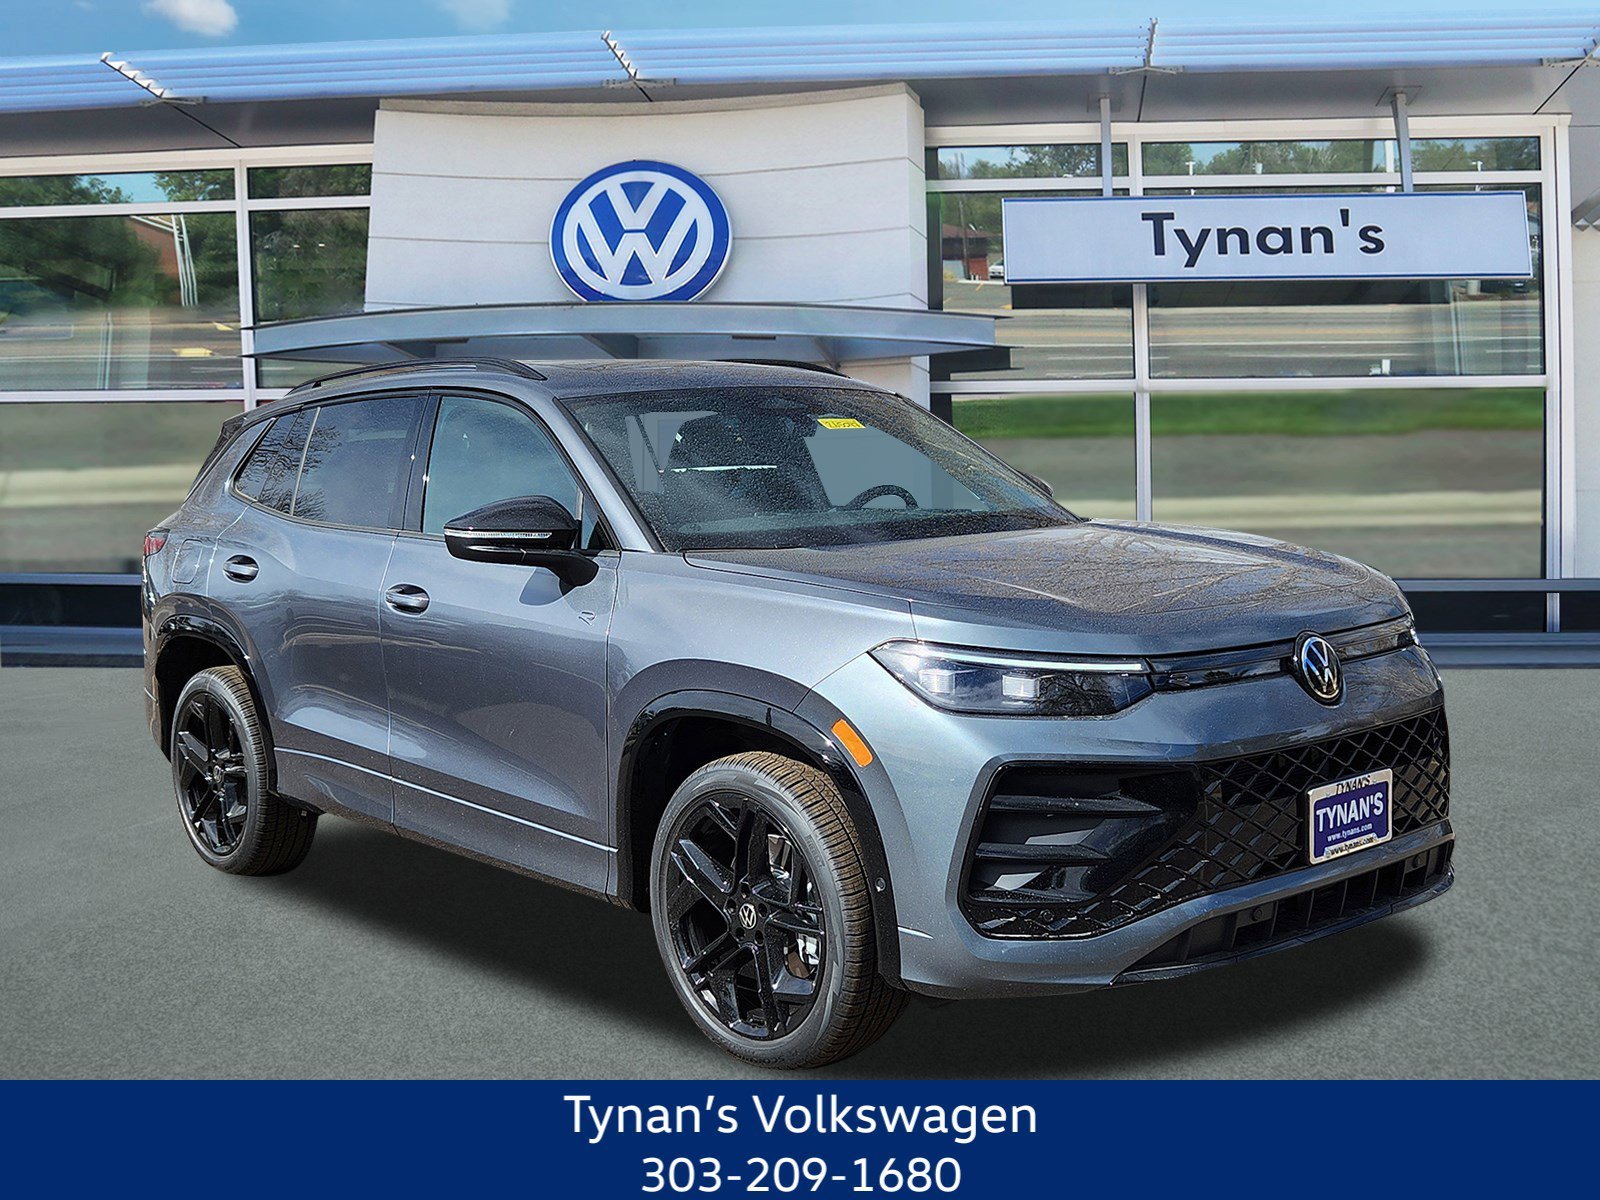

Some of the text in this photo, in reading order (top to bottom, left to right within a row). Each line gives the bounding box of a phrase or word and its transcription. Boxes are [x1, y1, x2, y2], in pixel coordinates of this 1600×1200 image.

[1142, 209, 1385, 268] Tynan's
[1316, 792, 1384, 832] TYNAN'S
[1327, 823, 1373, 842] www.tynans.com
